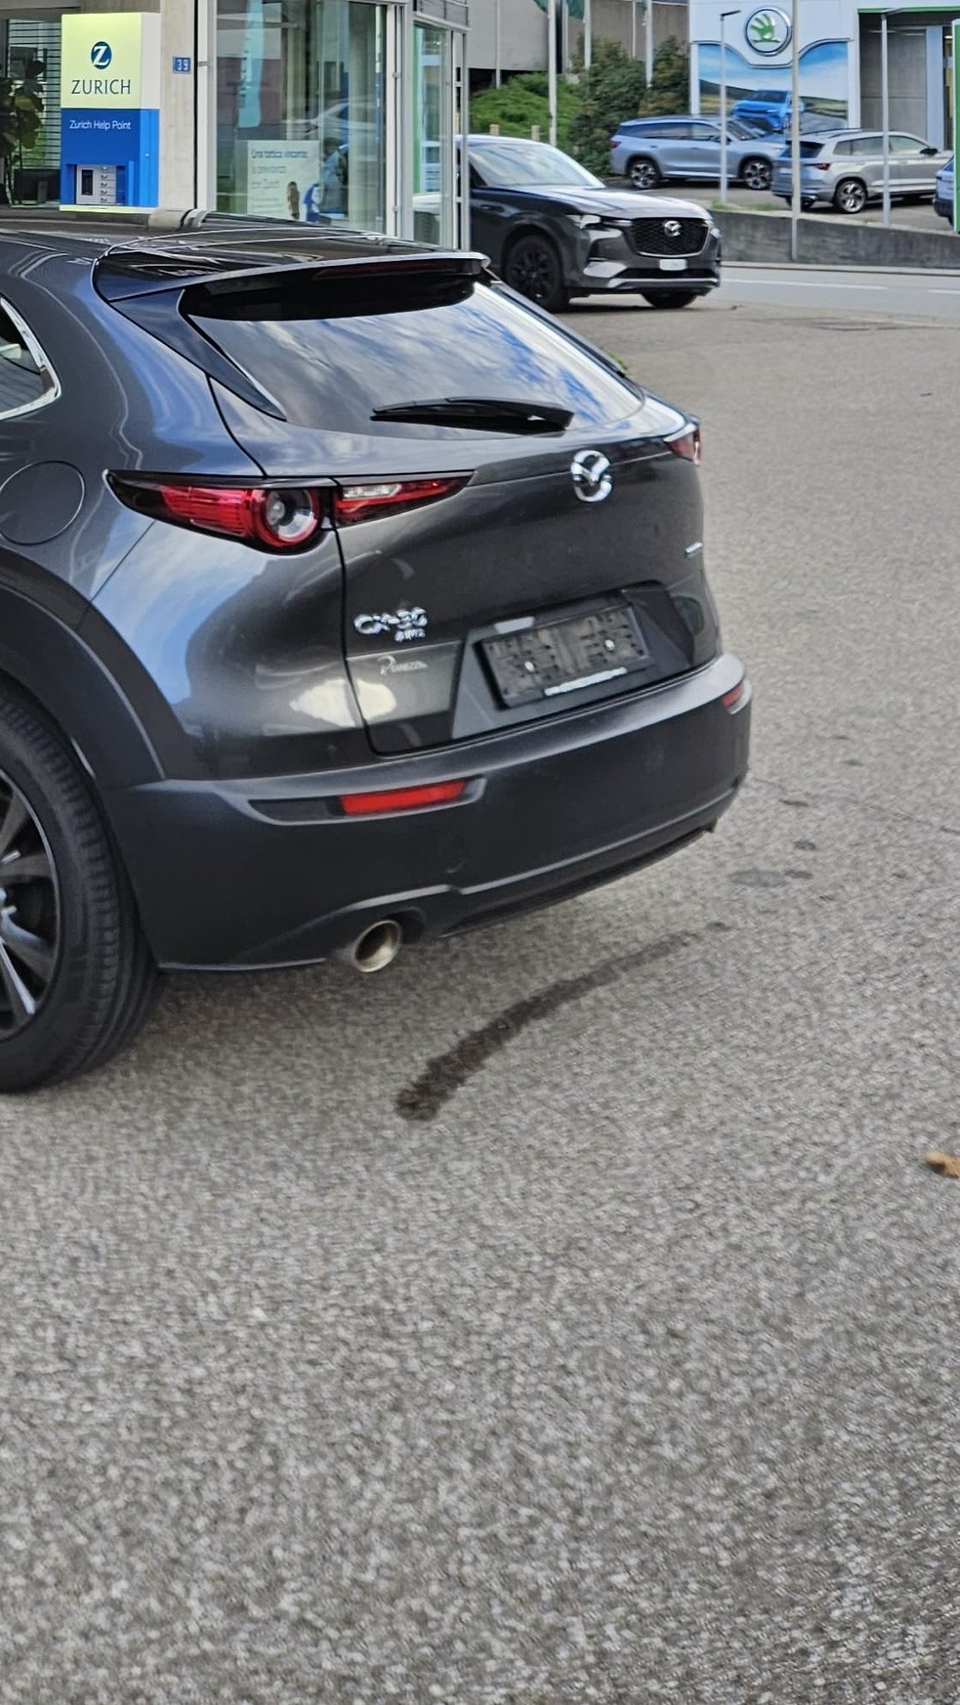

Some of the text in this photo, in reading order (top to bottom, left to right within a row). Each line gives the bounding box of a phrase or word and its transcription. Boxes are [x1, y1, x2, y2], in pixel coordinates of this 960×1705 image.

[71, 79, 131, 95] ZURICH
[69, 120, 131, 131] Zurich Help Point
